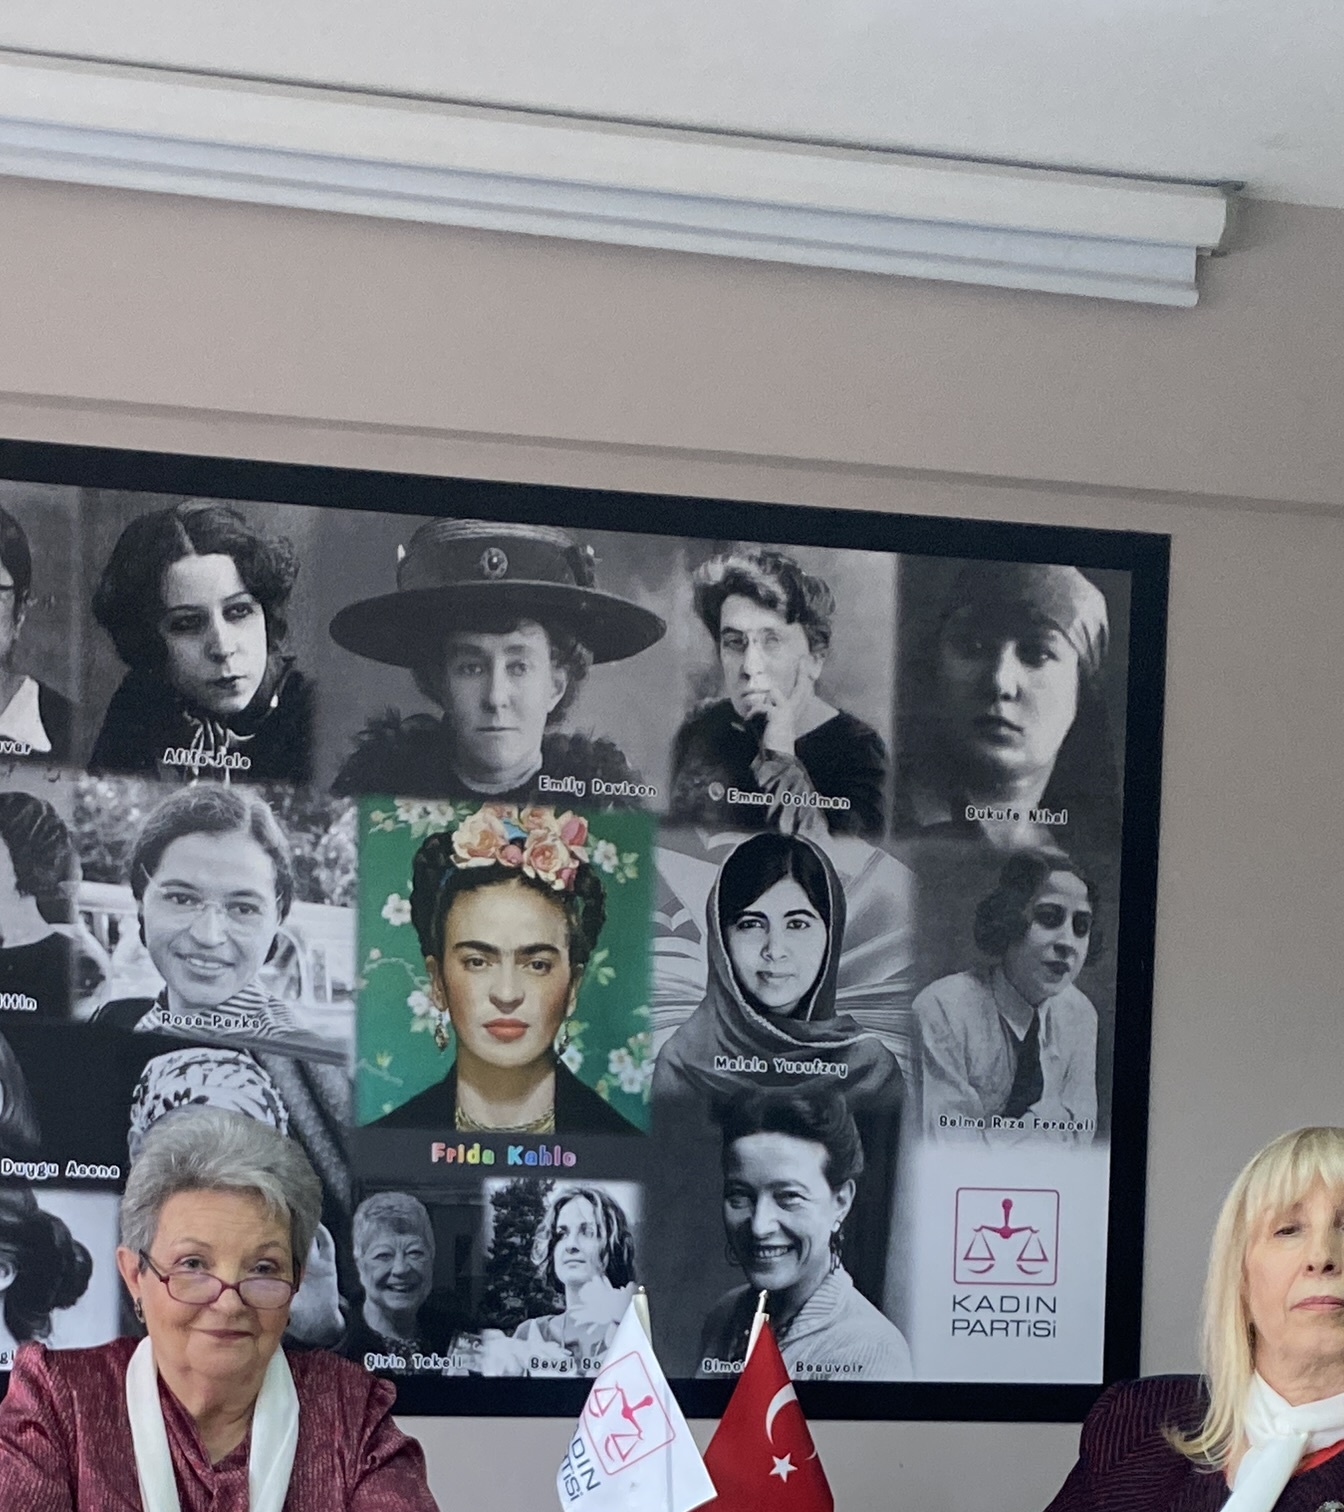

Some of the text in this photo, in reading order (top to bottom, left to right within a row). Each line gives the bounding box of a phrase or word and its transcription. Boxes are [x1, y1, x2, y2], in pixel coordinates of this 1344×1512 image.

[216, 752, 251, 769] Jale
[539, 775, 656, 797] Emily Davison
[727, 788, 851, 809] Emma Goldman
[1028, 808, 1068, 825] Nihal
[161, 1012, 261, 1029] Rosa Parks
[714, 1055, 768, 1072] Malala
[939, 1115, 985, 1128] Selma
[431, 1142, 577, 1167] Frida Kahlo
[1, 1158, 120, 1179] Duygu Asena
[952, 1294, 1057, 1314] KADIN
[413, 1354, 463, 1369] Tekeli
[530, 1357, 601, 1372] Sevgi So
[702, 1357, 864, 1373] Simo Beauvoir
[570, 1434, 601, 1491] DIN
